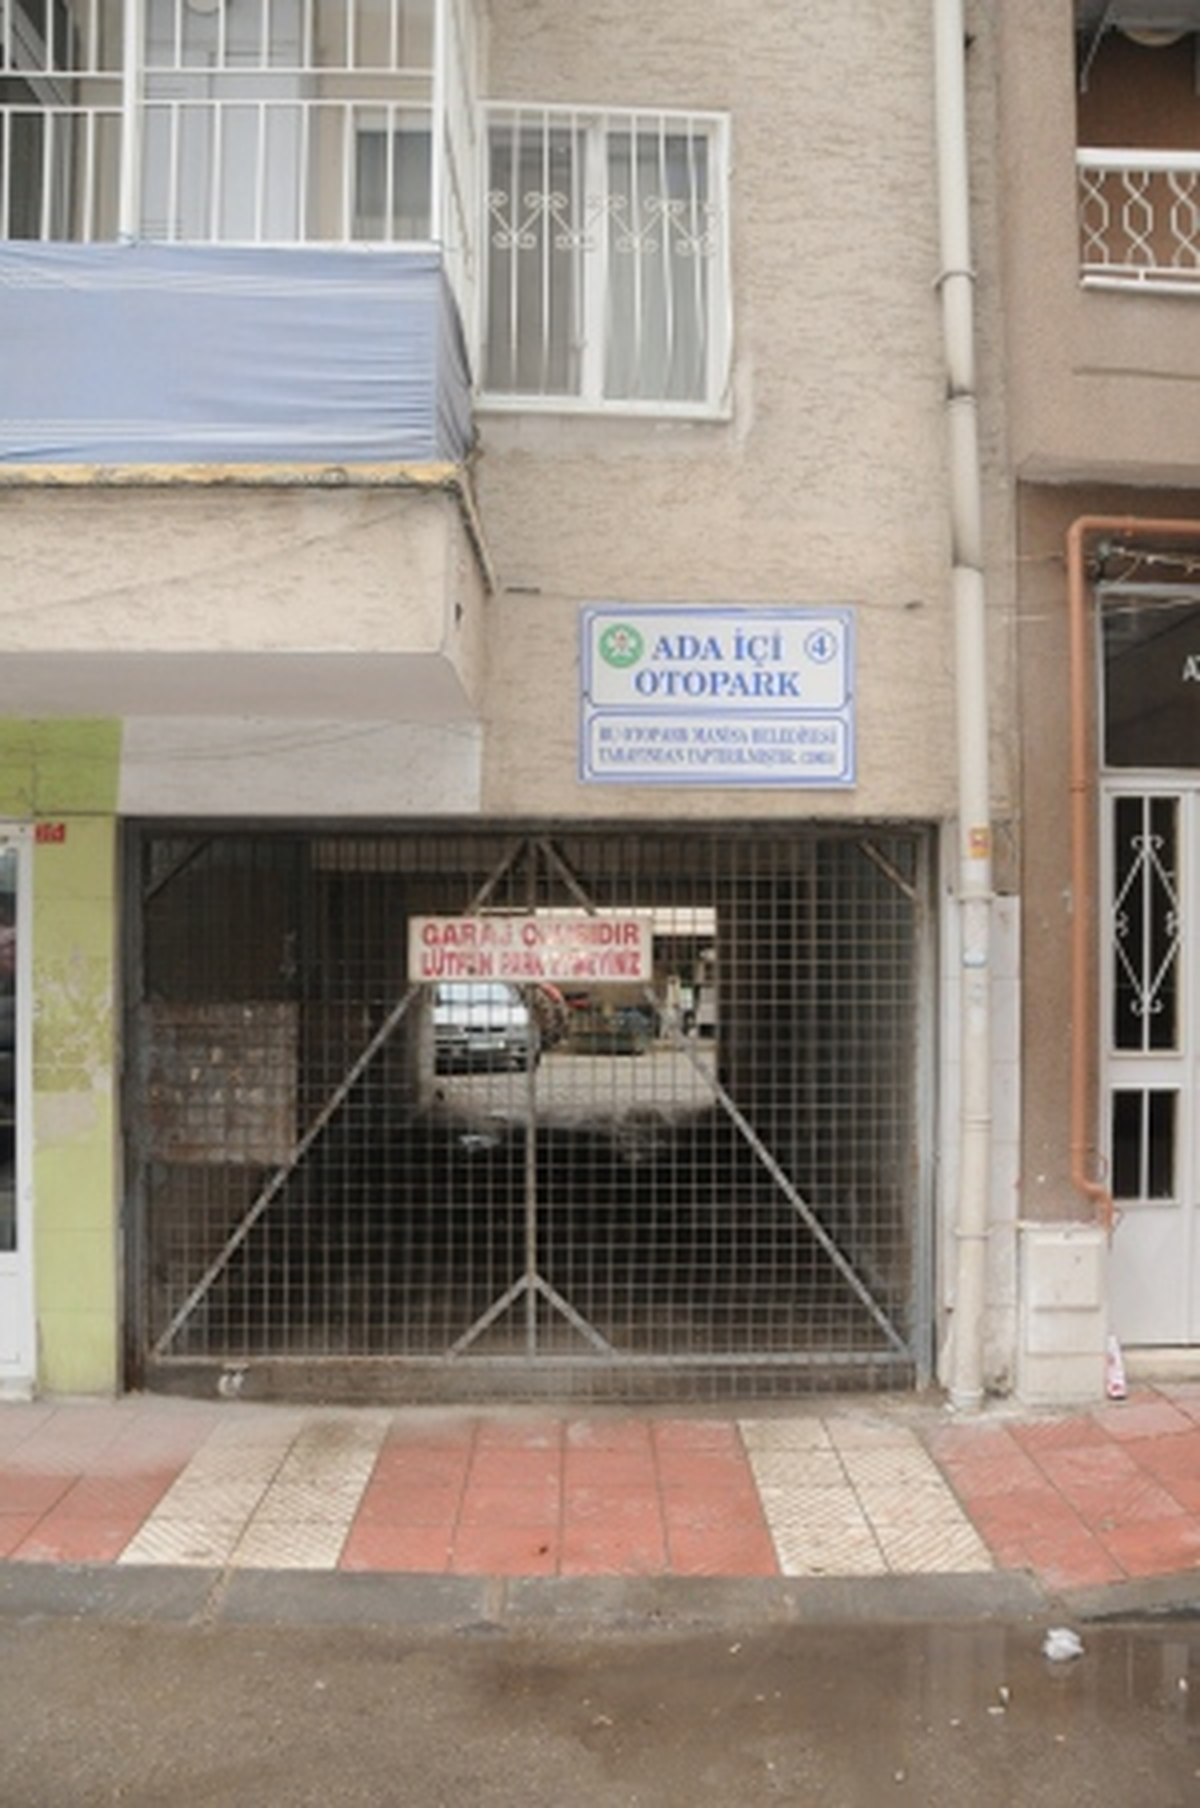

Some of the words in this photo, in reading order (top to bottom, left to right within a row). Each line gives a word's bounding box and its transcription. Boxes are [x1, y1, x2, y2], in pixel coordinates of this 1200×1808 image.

[651, 635, 724, 661] ADA
[734, 627, 782, 668] İÇİ
[811, 635, 827, 657] 4
[634, 670, 801, 697] OTOPARK
[423, 922, 513, 946] GARAJ
